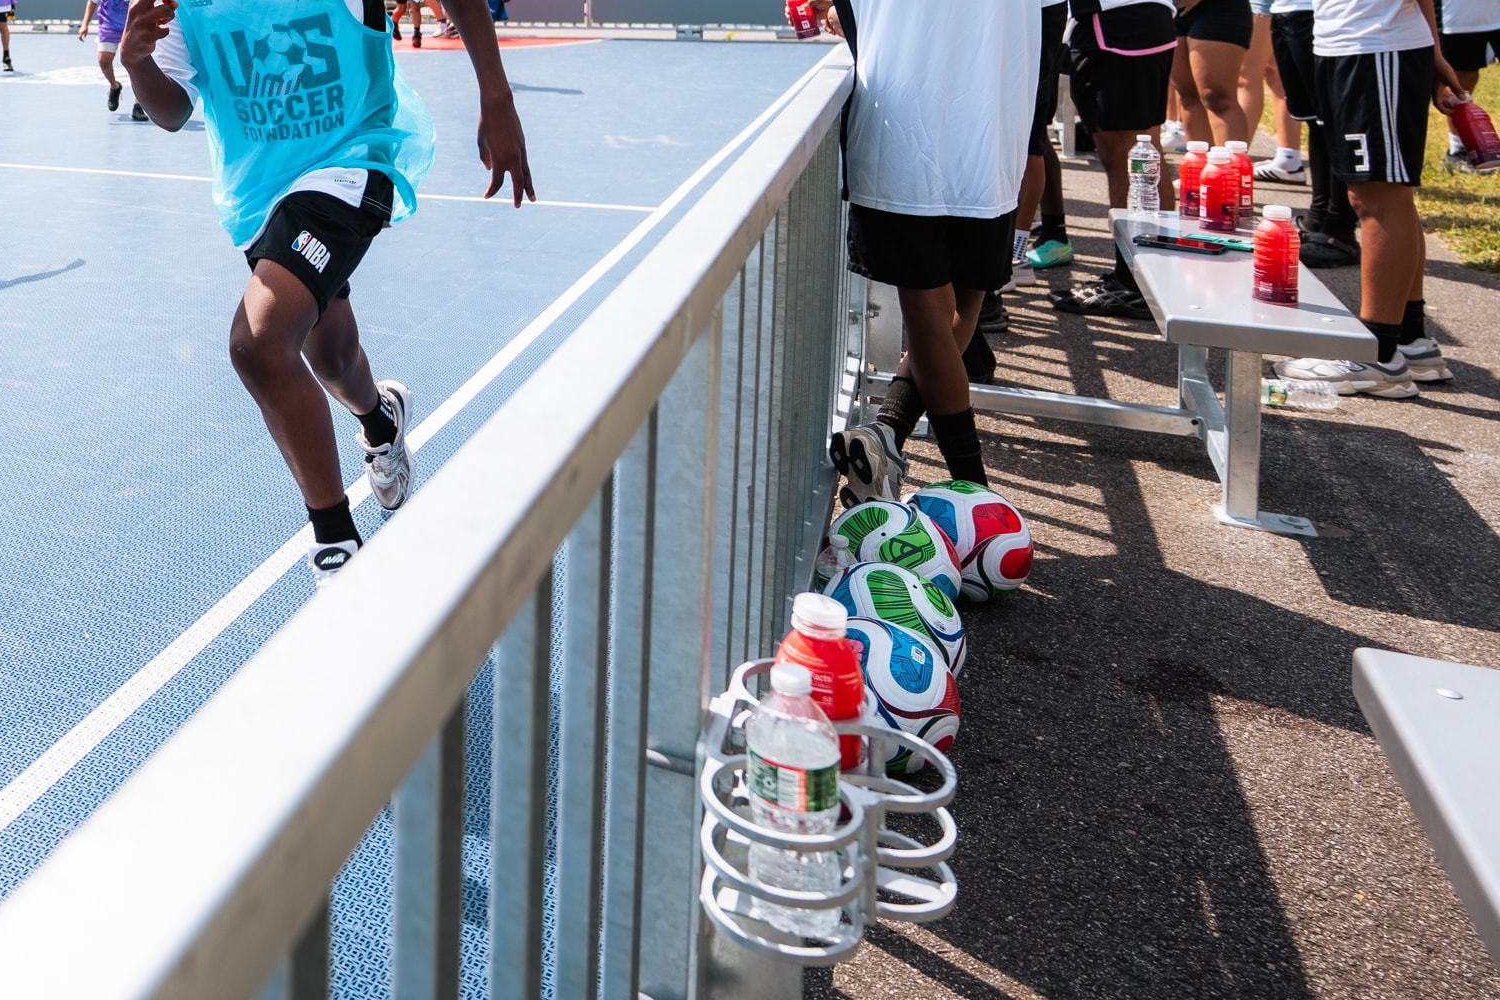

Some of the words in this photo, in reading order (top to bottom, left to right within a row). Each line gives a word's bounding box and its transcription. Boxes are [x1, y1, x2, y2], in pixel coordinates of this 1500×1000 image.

[234, 84, 344, 126] SOCCER
[1344, 133, 1370, 172] 3
[301, 236, 331, 274] NBA
